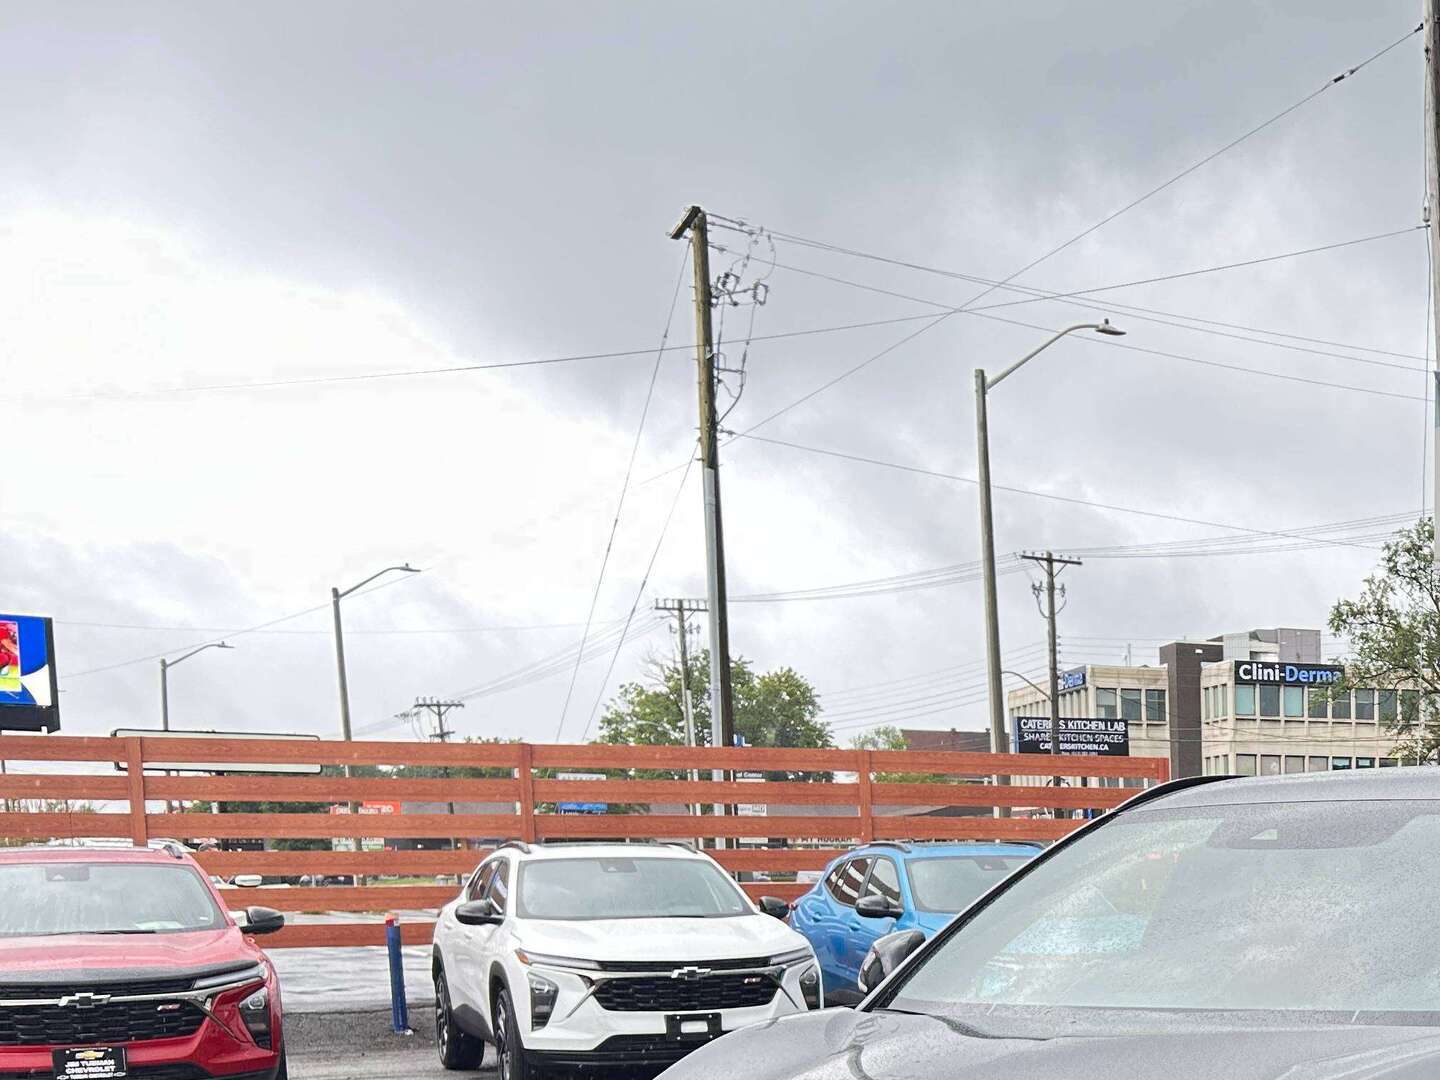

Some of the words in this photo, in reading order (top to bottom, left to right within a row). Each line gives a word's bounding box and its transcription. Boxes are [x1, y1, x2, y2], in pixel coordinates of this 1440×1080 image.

[1239, 663, 1342, 683] Clini-Derma
[1020, 718, 1065, 730] CATERS
[1068, 720, 1105, 731] KITCHEN
[1108, 721, 1126, 732] LAB
[1024, 732, 1052, 742] SHARE
[1095, 734, 1124, 743] SPACES
